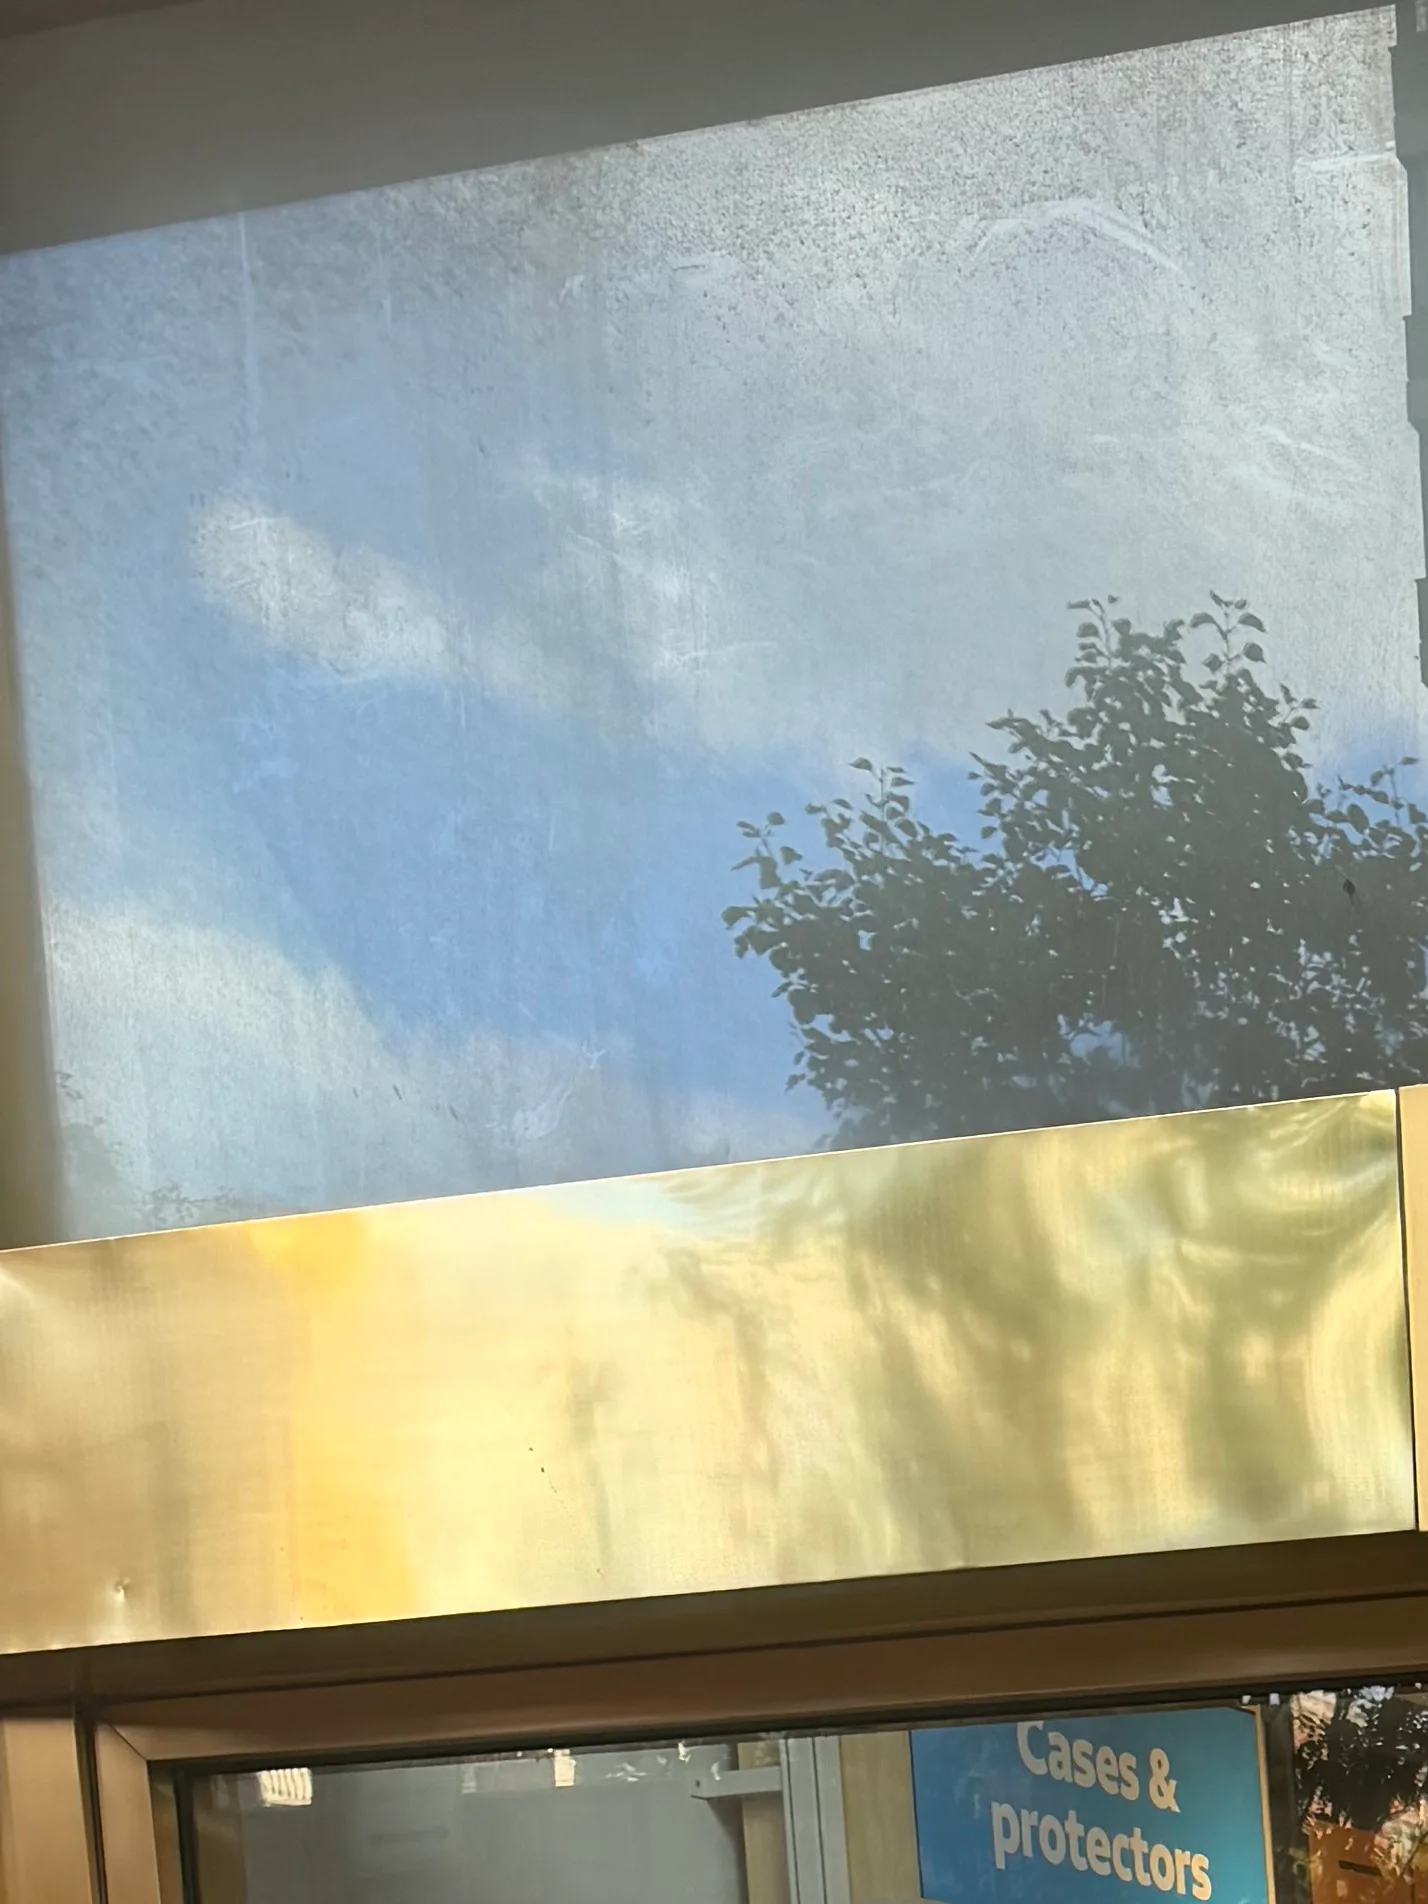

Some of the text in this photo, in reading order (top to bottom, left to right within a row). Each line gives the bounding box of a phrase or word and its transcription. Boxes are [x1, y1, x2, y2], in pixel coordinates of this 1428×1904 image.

[1017, 1720, 1181, 1813] Cases &
[991, 1799, 1213, 1901] protectors
